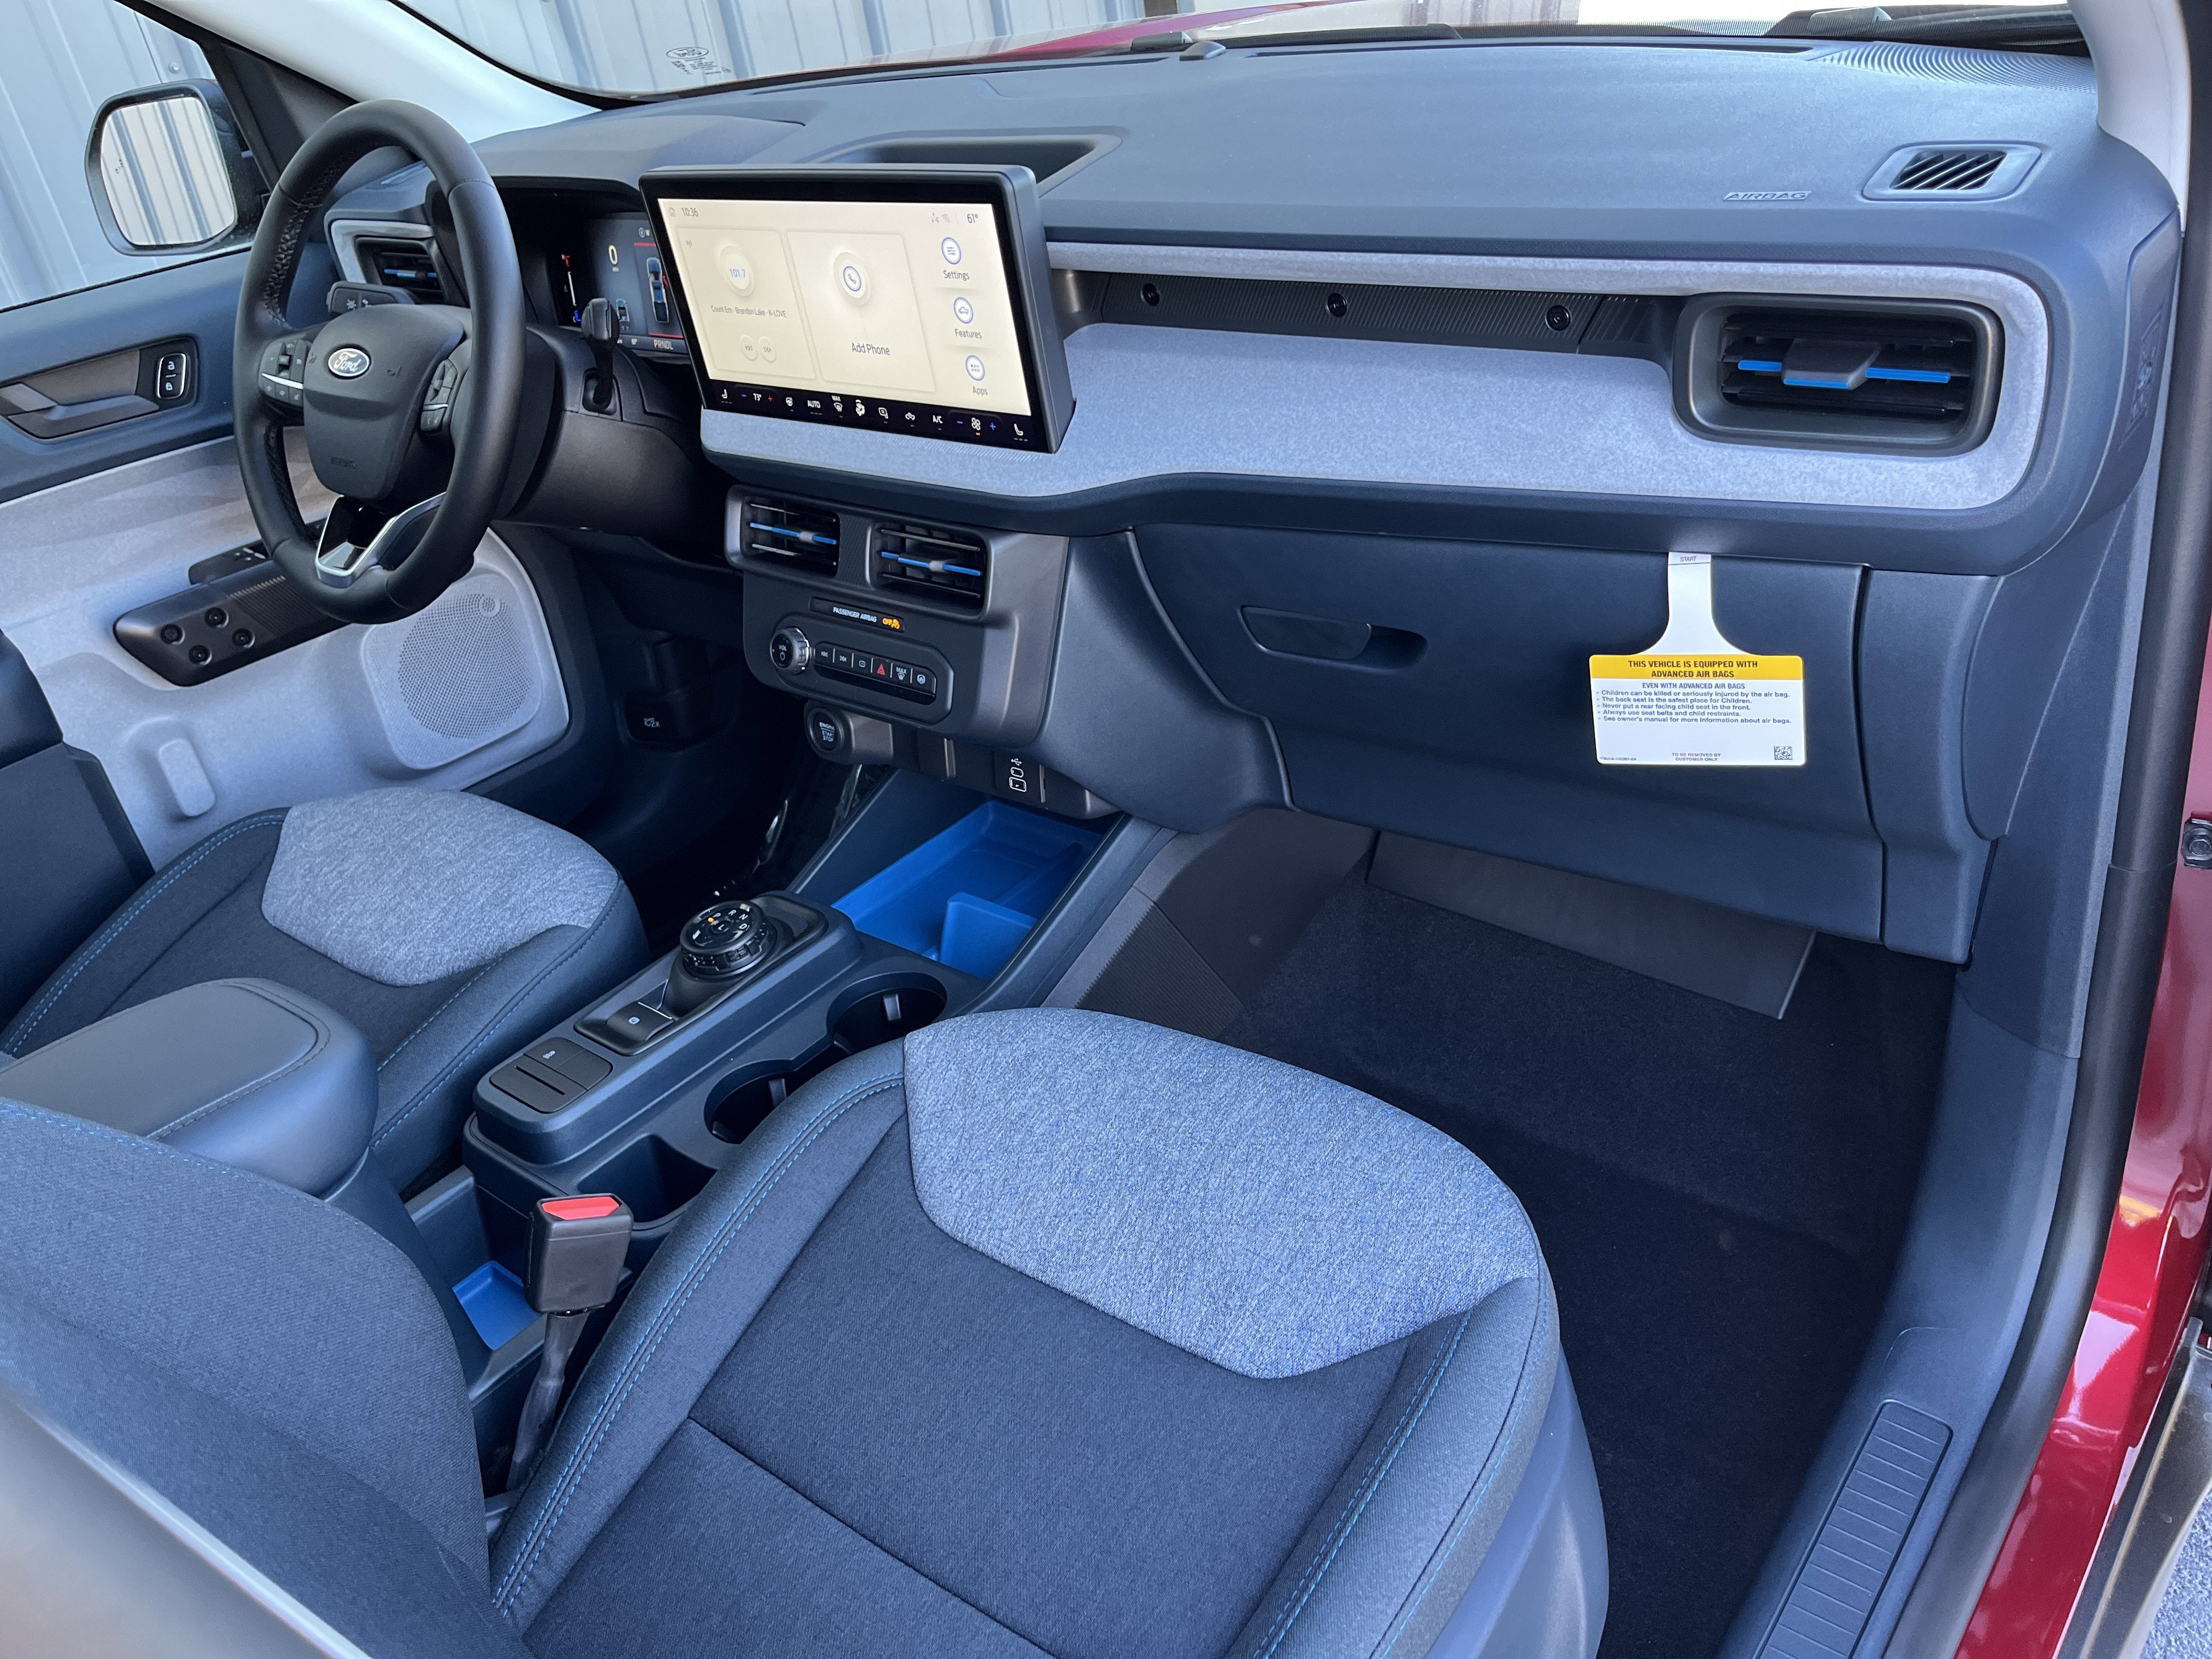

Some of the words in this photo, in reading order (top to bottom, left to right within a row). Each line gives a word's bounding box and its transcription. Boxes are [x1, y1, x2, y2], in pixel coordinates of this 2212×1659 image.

[681, 207, 699, 217] 10:36
[967, 213, 978, 223] 61°
[729, 268, 746, 278] 101.7
[943, 270, 970, 281] Settings
[735, 307, 754, 315] Brandon
[768, 309, 787, 318] K-LOVE
[955, 329, 982, 339] Features
[851, 342, 866, 353] Add
[866, 343, 890, 356] Phone
[334, 351, 362, 373] Ford
[973, 386, 988, 396] Apps
[808, 400, 821, 408] AUTO
[833, 606, 860, 618] PASSENGER
[860, 613, 877, 623] AIRBAG
